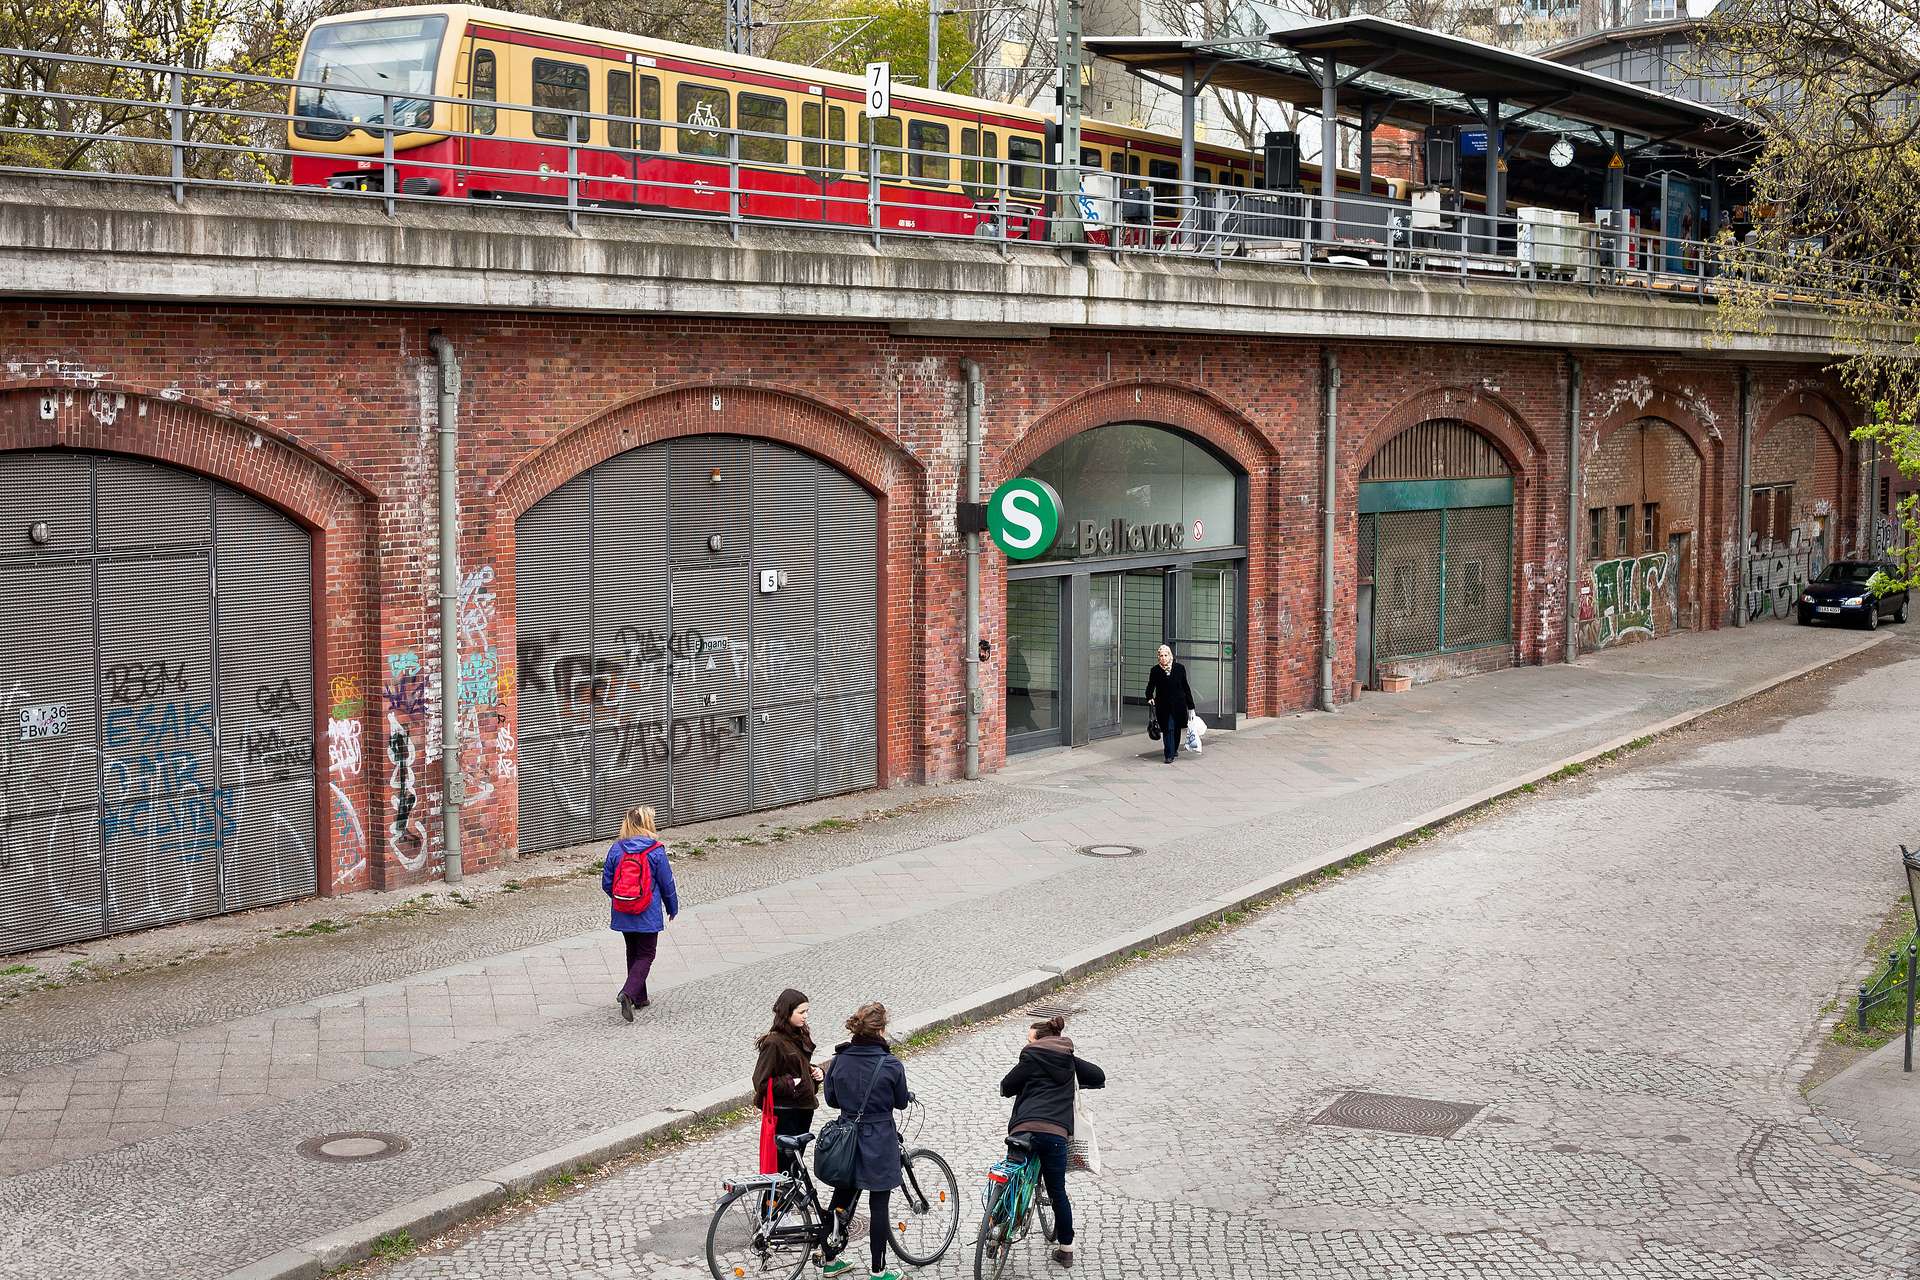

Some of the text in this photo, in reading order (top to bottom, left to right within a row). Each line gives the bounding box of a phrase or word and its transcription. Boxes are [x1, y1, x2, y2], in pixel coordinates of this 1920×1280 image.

[873, 66, 882, 87] 7
[871, 90, 883, 109] 0
[43, 400, 52, 414] 4
[1001, 489, 1043, 549] S
[1079, 518, 1185, 555] Bellevue
[768, 575, 775, 588] 5
[50, 706, 67, 719] 36
[20, 721, 68, 738] FBw 32
